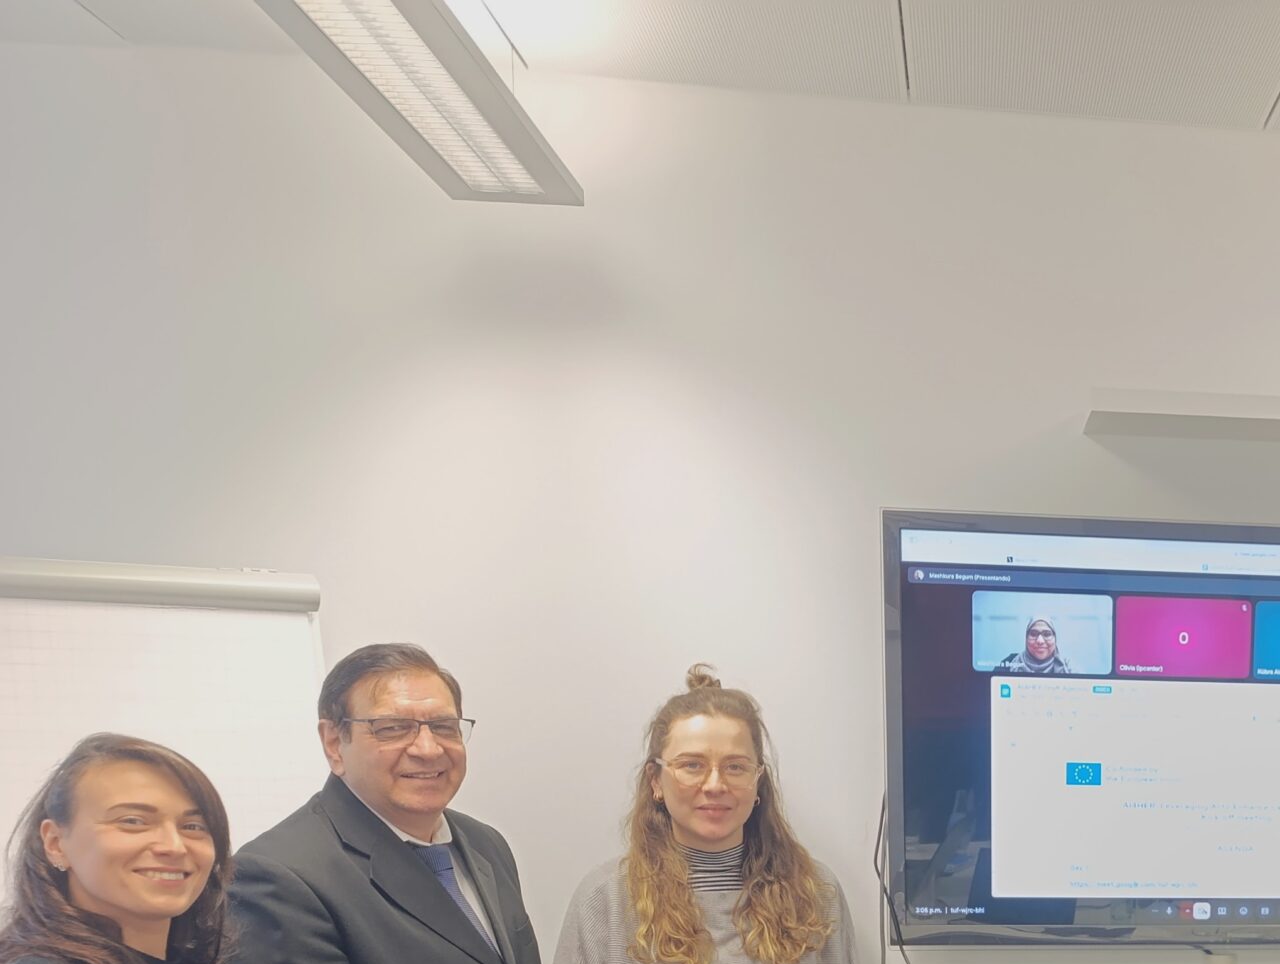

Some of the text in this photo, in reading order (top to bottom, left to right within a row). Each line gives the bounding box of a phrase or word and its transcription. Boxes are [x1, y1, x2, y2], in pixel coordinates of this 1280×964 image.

[955, 573, 973, 581] Begum
[974, 574, 1011, 582] (Presentando)
[1179, 632, 1189, 644] O
